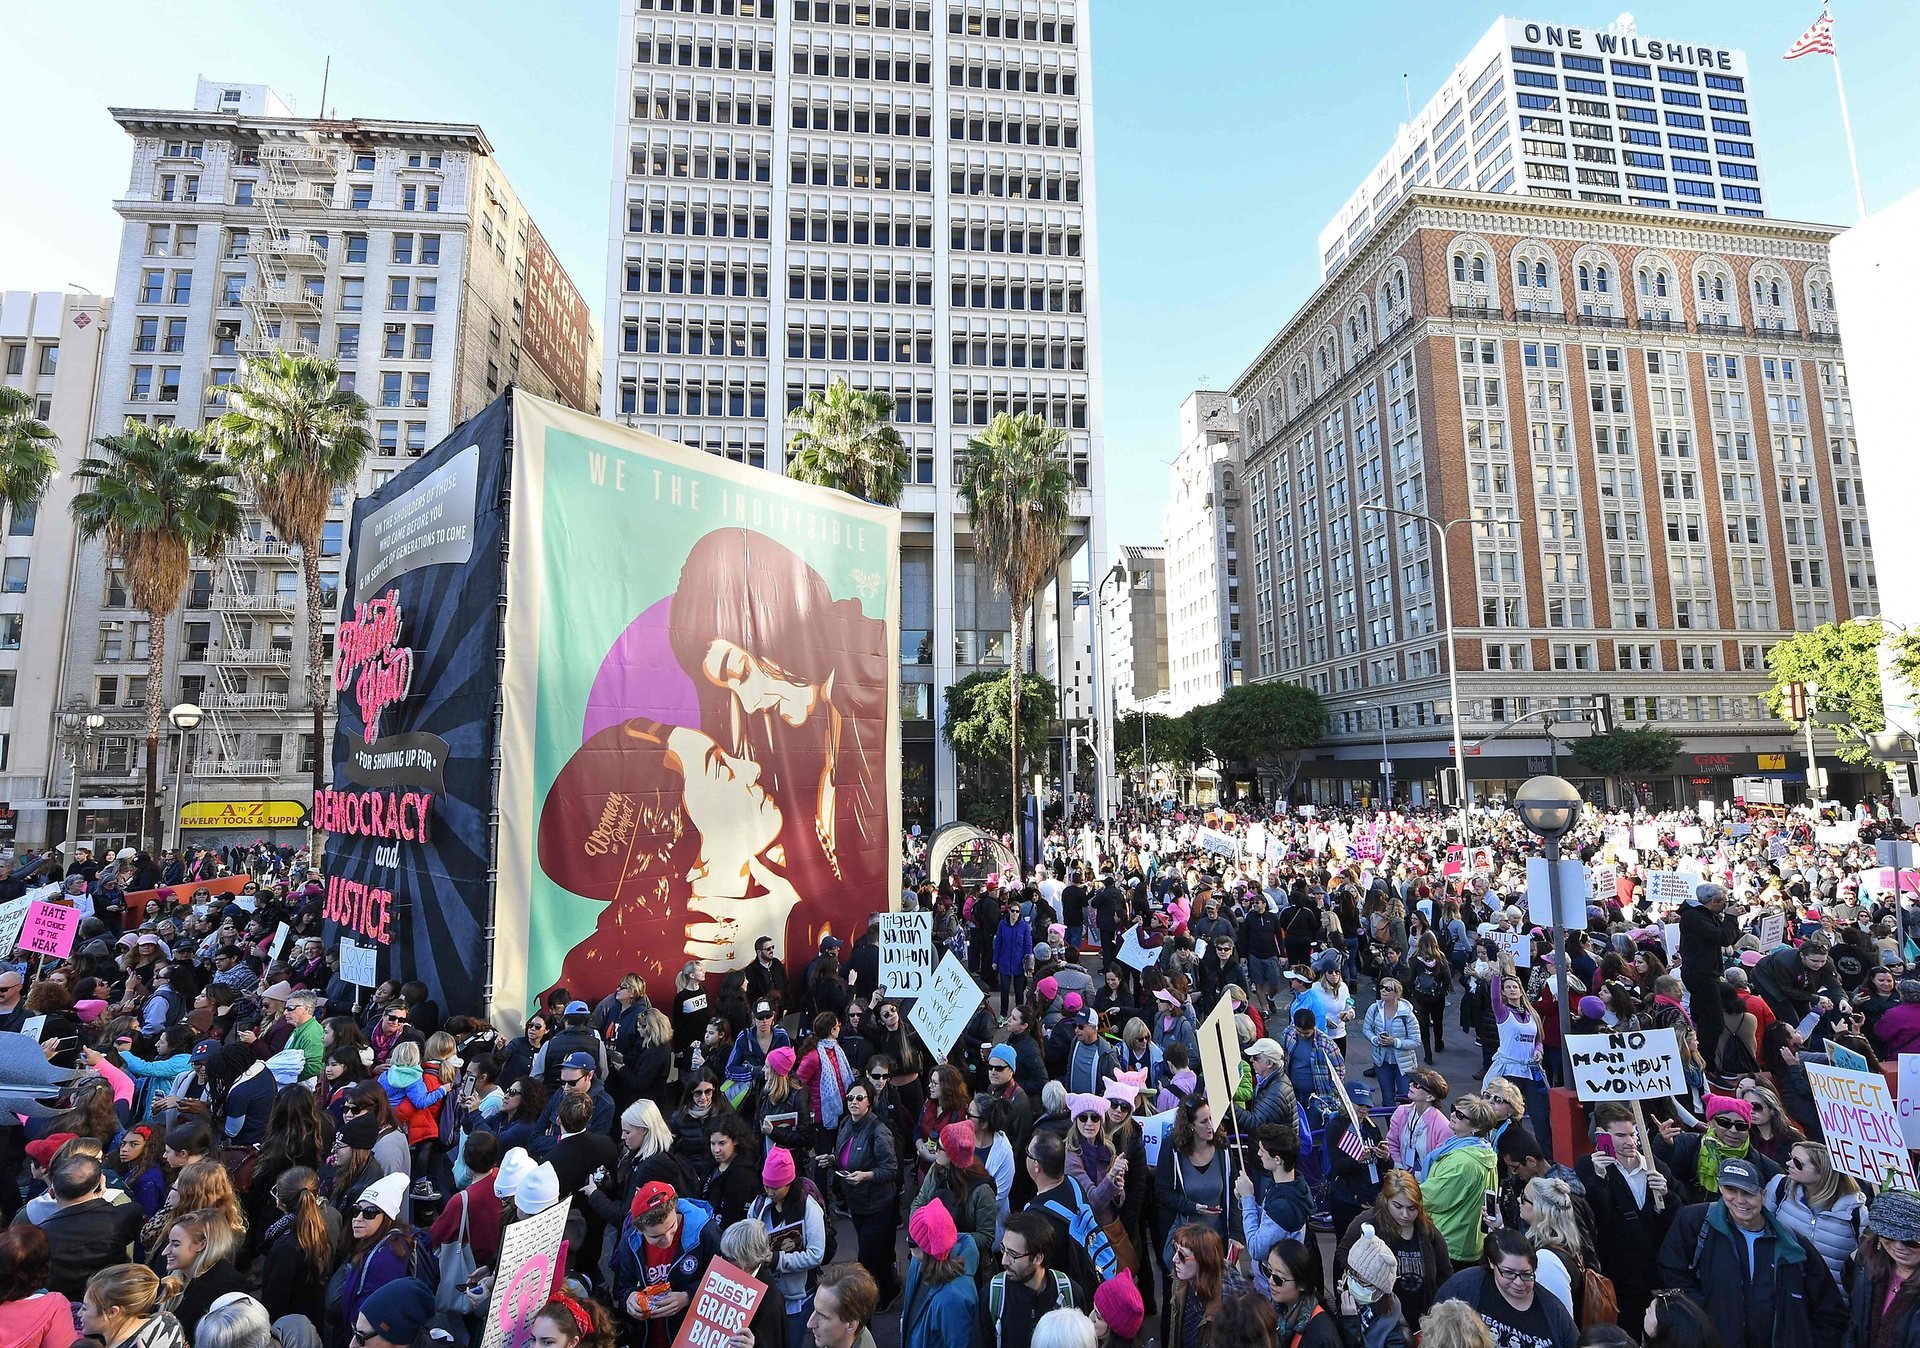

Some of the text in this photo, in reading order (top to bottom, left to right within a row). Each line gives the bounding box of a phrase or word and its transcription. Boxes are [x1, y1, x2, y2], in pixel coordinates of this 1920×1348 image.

[1525, 23, 1732, 70] ONE WILSHIRE
[544, 252, 577, 318] PARK
[529, 265, 584, 360] CENTRAL
[529, 299, 581, 380] BUILDING
[374, 473, 457, 536] ON THE SHOULDERS OF THOSE
[589, 451, 865, 552] WE THE INDIVISIBLE
[379, 502, 443, 553] WHO CAME BEFORE YOU
[364, 573, 371, 585] IN
[371, 555, 389, 582] SERVICE
[389, 549, 396, 565] OF
[396, 532, 435, 559] GENERATIONS
[436, 529, 445, 544] TO
[446, 525, 466, 541] COME
[359, 749, 433, 772] FOR SHOWING UP FOR
[1694, 754, 1734, 765] GNC
[180, 816, 300, 825] JEWELRY TOOLS & SUPPLY
[220, 803, 236, 816] A
[248, 803, 263, 816] Z
[314, 789, 433, 844] DEMOCRACY
[584, 791, 623, 857] Women
[611, 794, 636, 845] Perfect!
[375, 842, 400, 869] and
[35, 917, 42, 925] IS
[46, 920, 66, 931] CHOICE
[40, 905, 67, 920] HATE
[322, 875, 392, 945] JUSTICE
[32, 937, 58, 953] WEAK
[38, 928, 58, 940] OF THE
[341, 945, 373, 967] LOVE
[883, 946, 929, 967] Nation
[886, 970, 922, 992] One
[1608, 1032, 1646, 1050] NO
[1572, 1052, 1624, 1067] MAN
[1586, 1076, 1672, 1094] WOMAN
[1808, 1071, 1882, 1111] PROTECT
[1815, 1098, 1904, 1149] WOMEN'S
[1827, 1134, 1919, 1190] HEALTH
[706, 1276, 755, 1306] PUSSY
[696, 1293, 747, 1333] GRABS
[1481, 1313, 1511, 1333] TEGAN
[1512, 1327, 1533, 1344] AND
